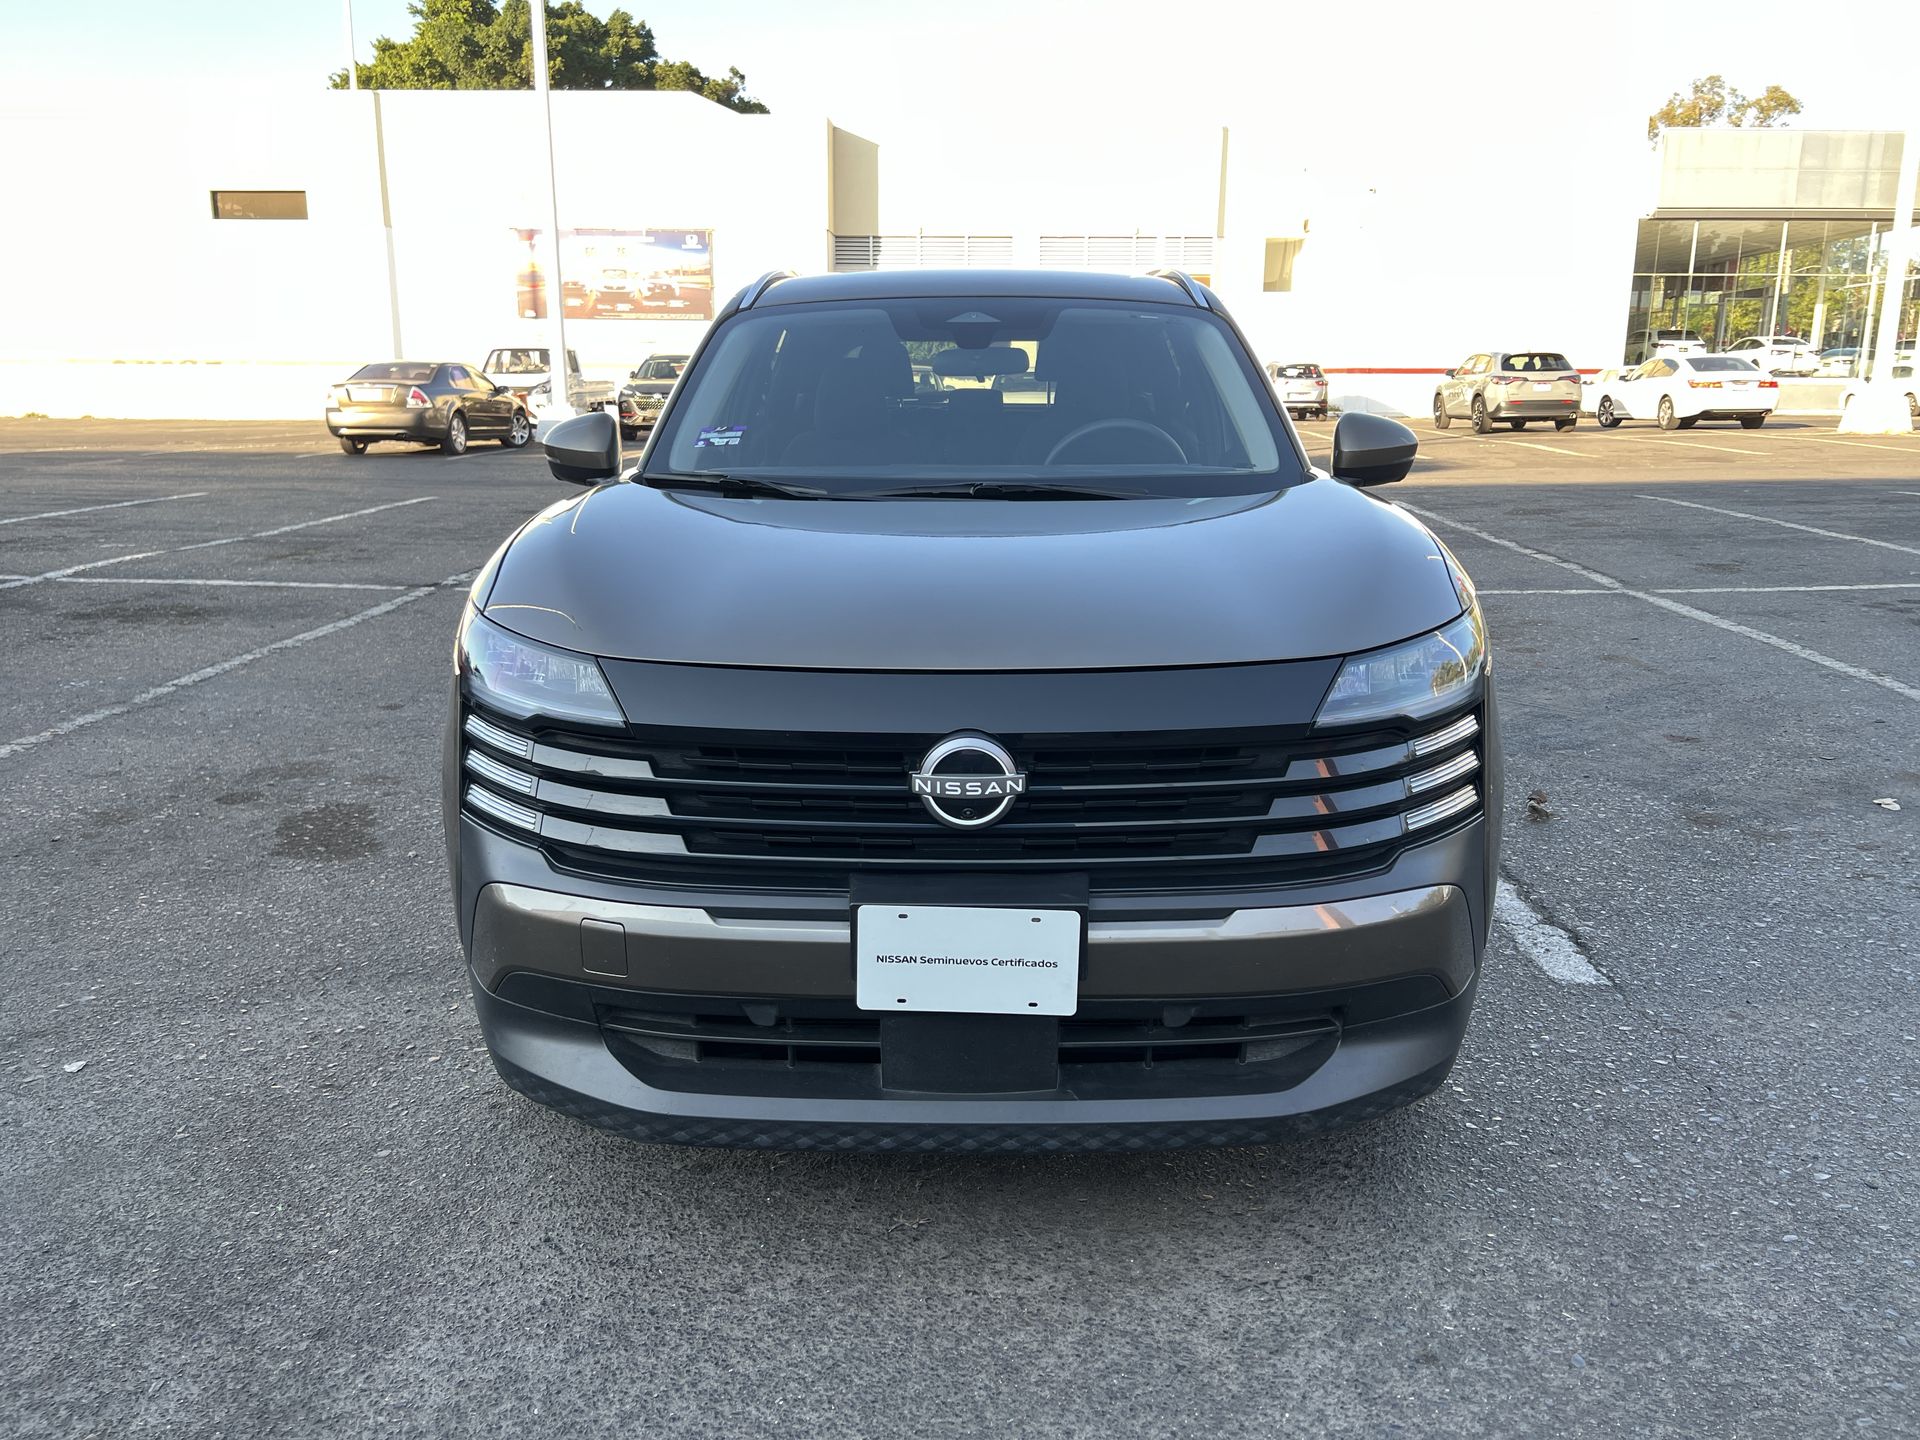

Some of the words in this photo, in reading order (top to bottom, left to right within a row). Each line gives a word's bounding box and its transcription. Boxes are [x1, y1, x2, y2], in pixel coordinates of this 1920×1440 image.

[914, 778, 1023, 796] NISSAN
[876, 954, 917, 965] NISSAN
[919, 955, 989, 967] Seminuevos
[991, 957, 1058, 969] Certificados
